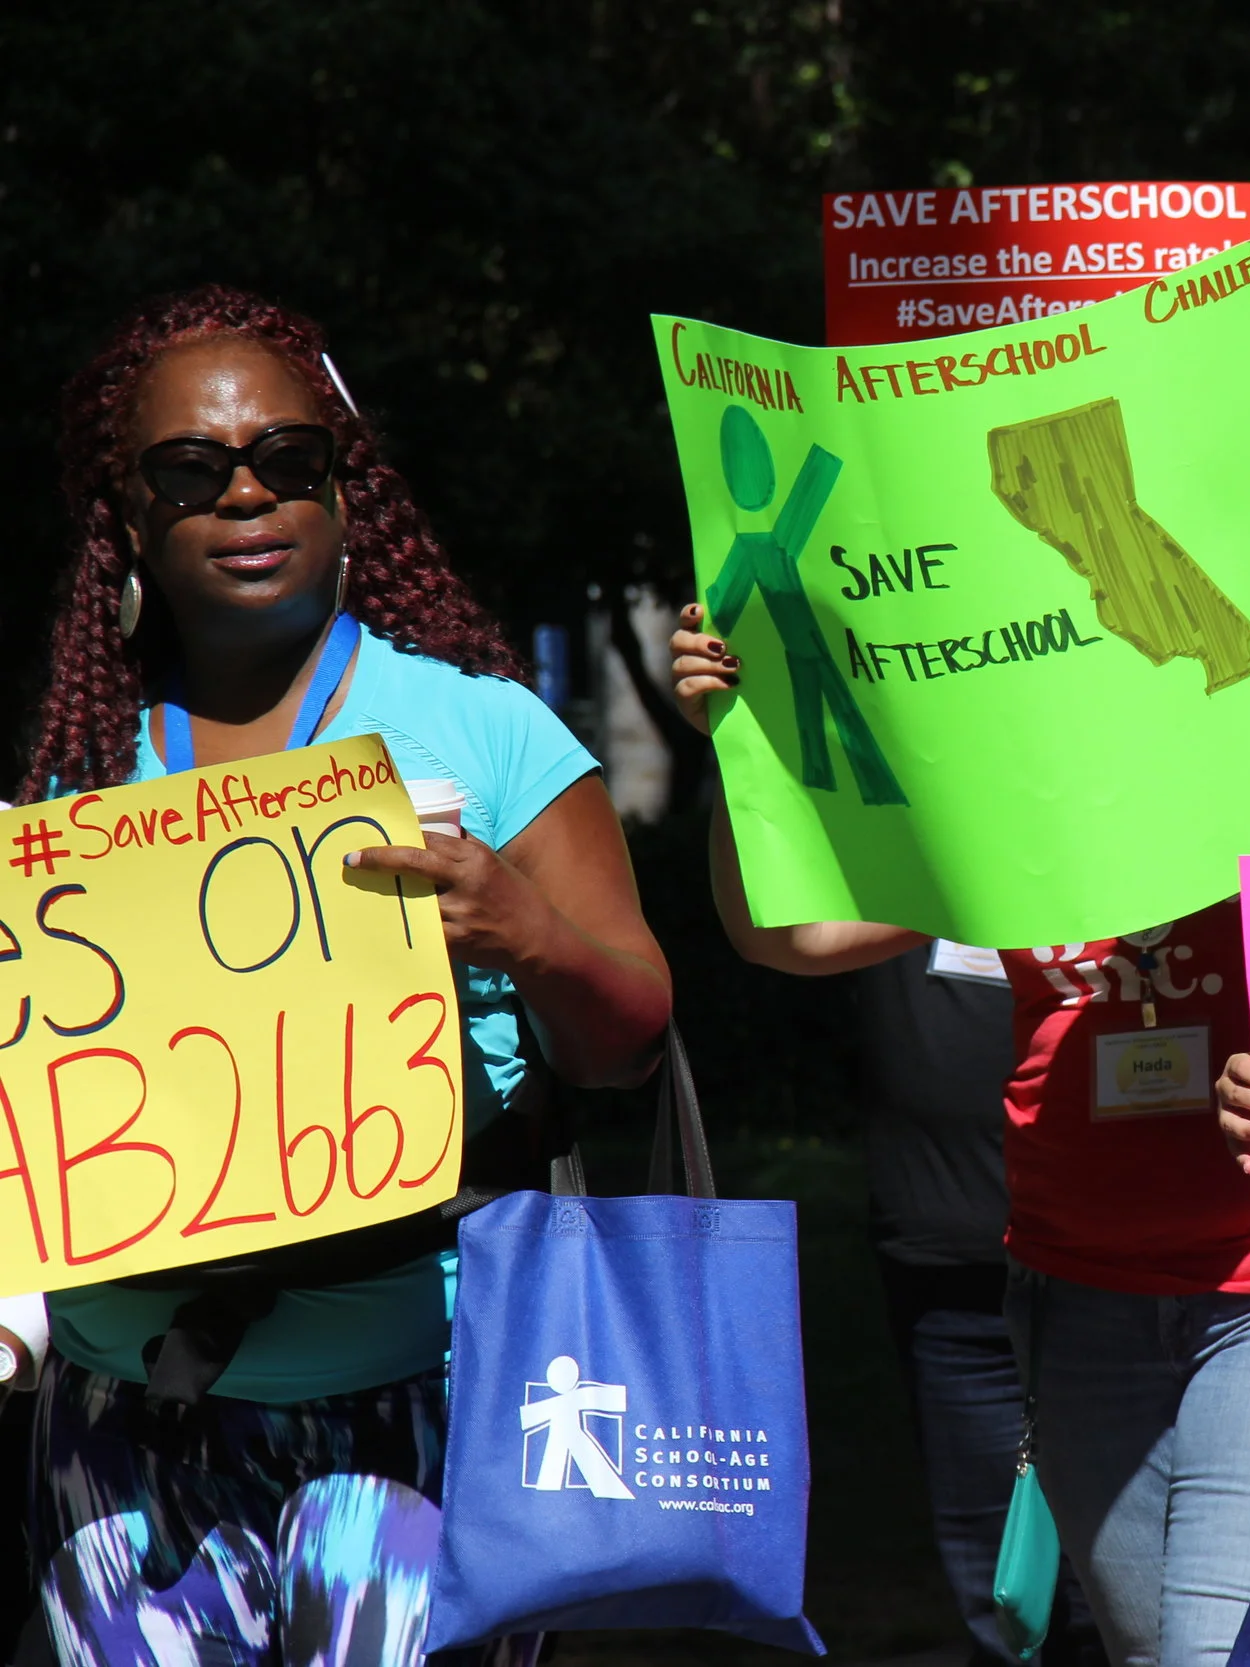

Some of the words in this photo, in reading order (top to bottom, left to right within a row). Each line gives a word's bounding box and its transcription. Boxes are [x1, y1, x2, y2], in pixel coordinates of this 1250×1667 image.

[833, 191, 937, 230] SAVE
[950, 185, 1247, 225] AFTERSCHOOL
[849, 251, 987, 282] Increase
[997, 245, 1057, 276] the
[1062, 243, 1145, 273] ASES
[671, 322, 804, 414] CALIFORNIA
[834, 324, 1107, 403] AFTERSCHOOL
[830, 543, 958, 601] SAVE
[845, 609, 1103, 683] AFTERSCHOOL
[199, 815, 413, 973] on
[1133, 1057, 1172, 1073] Hada
[634, 1423, 768, 1443] CALIFRNIA
[634, 1471, 771, 1491] CONSORTIUM
